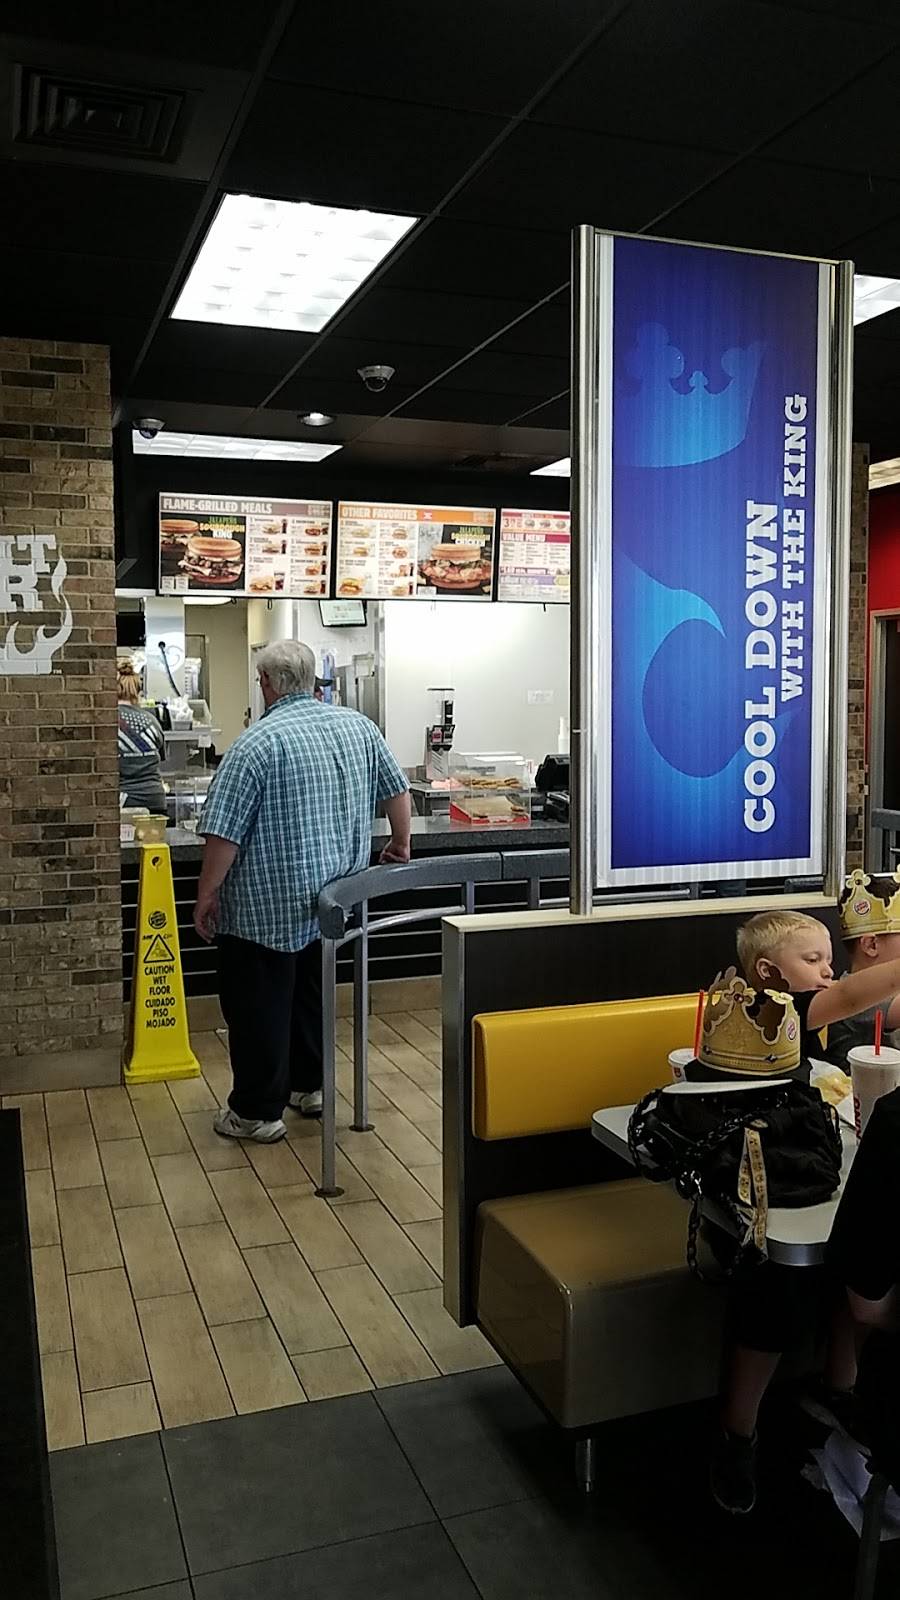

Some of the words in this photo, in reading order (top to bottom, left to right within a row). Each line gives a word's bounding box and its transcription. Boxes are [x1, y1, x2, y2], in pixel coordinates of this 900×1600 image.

[784, 394, 807, 497] KING
[163, 498, 238, 512] FLAME-GRILLED
[241, 502, 273, 514] MEALS
[342, 506, 371, 519] OTHER
[783, 509, 805, 589] THE
[745, 500, 778, 669] DOWN
[781, 600, 804, 702] WITH
[744, 687, 776, 832] COOL
[144, 965, 175, 976] CAUTION
[153, 976, 167, 985] WET
[149, 985, 171, 995] FLOOR
[145, 997, 176, 1008] CUIDADO
[153, 1008, 168, 1017] PISO
[146, 1017, 176, 1028] MOJADO
